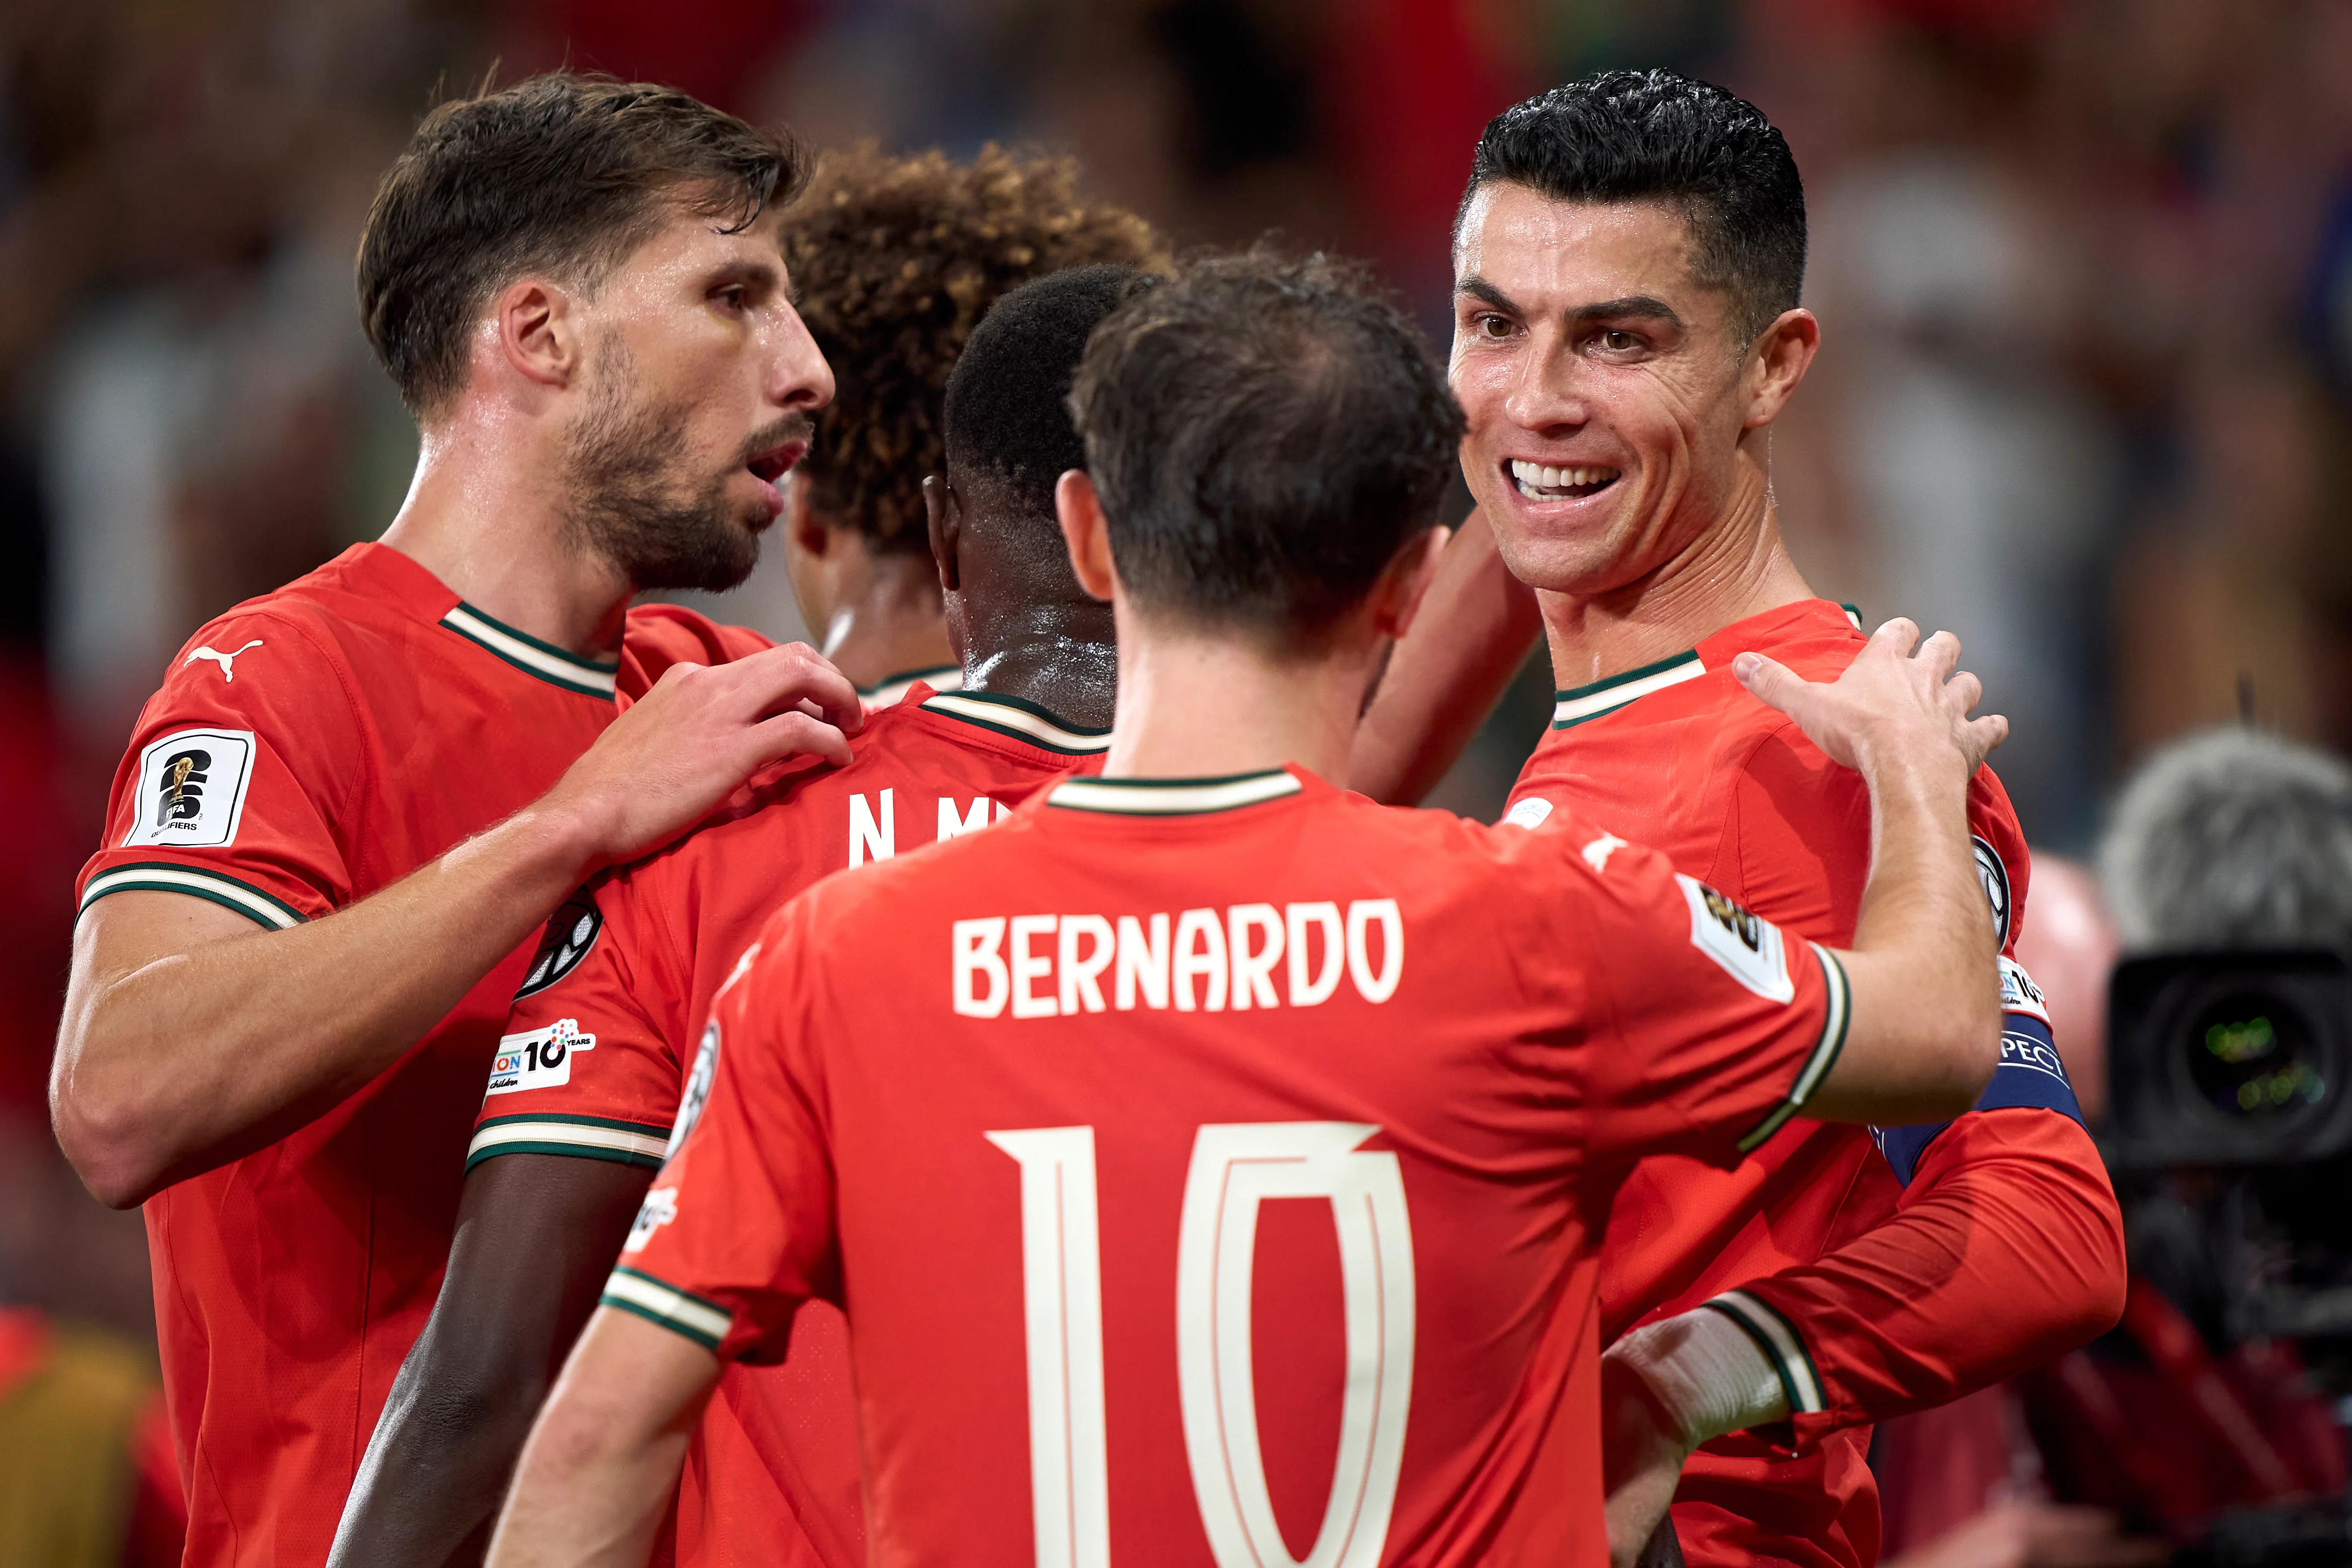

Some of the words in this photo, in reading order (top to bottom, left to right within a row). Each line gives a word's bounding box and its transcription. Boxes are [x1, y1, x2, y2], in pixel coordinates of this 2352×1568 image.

[166, 804, 185, 818] FIFA
[151, 822, 197, 837] QUALIFIERS
[849, 788, 894, 871] N
[937, 797, 1013, 844] M
[952, 898, 1404, 1019] BERNARDO
[524, 1040, 566, 1071] 10
[490, 1078, 518, 1089] children
[984, 1120, 1416, 1568] 10
